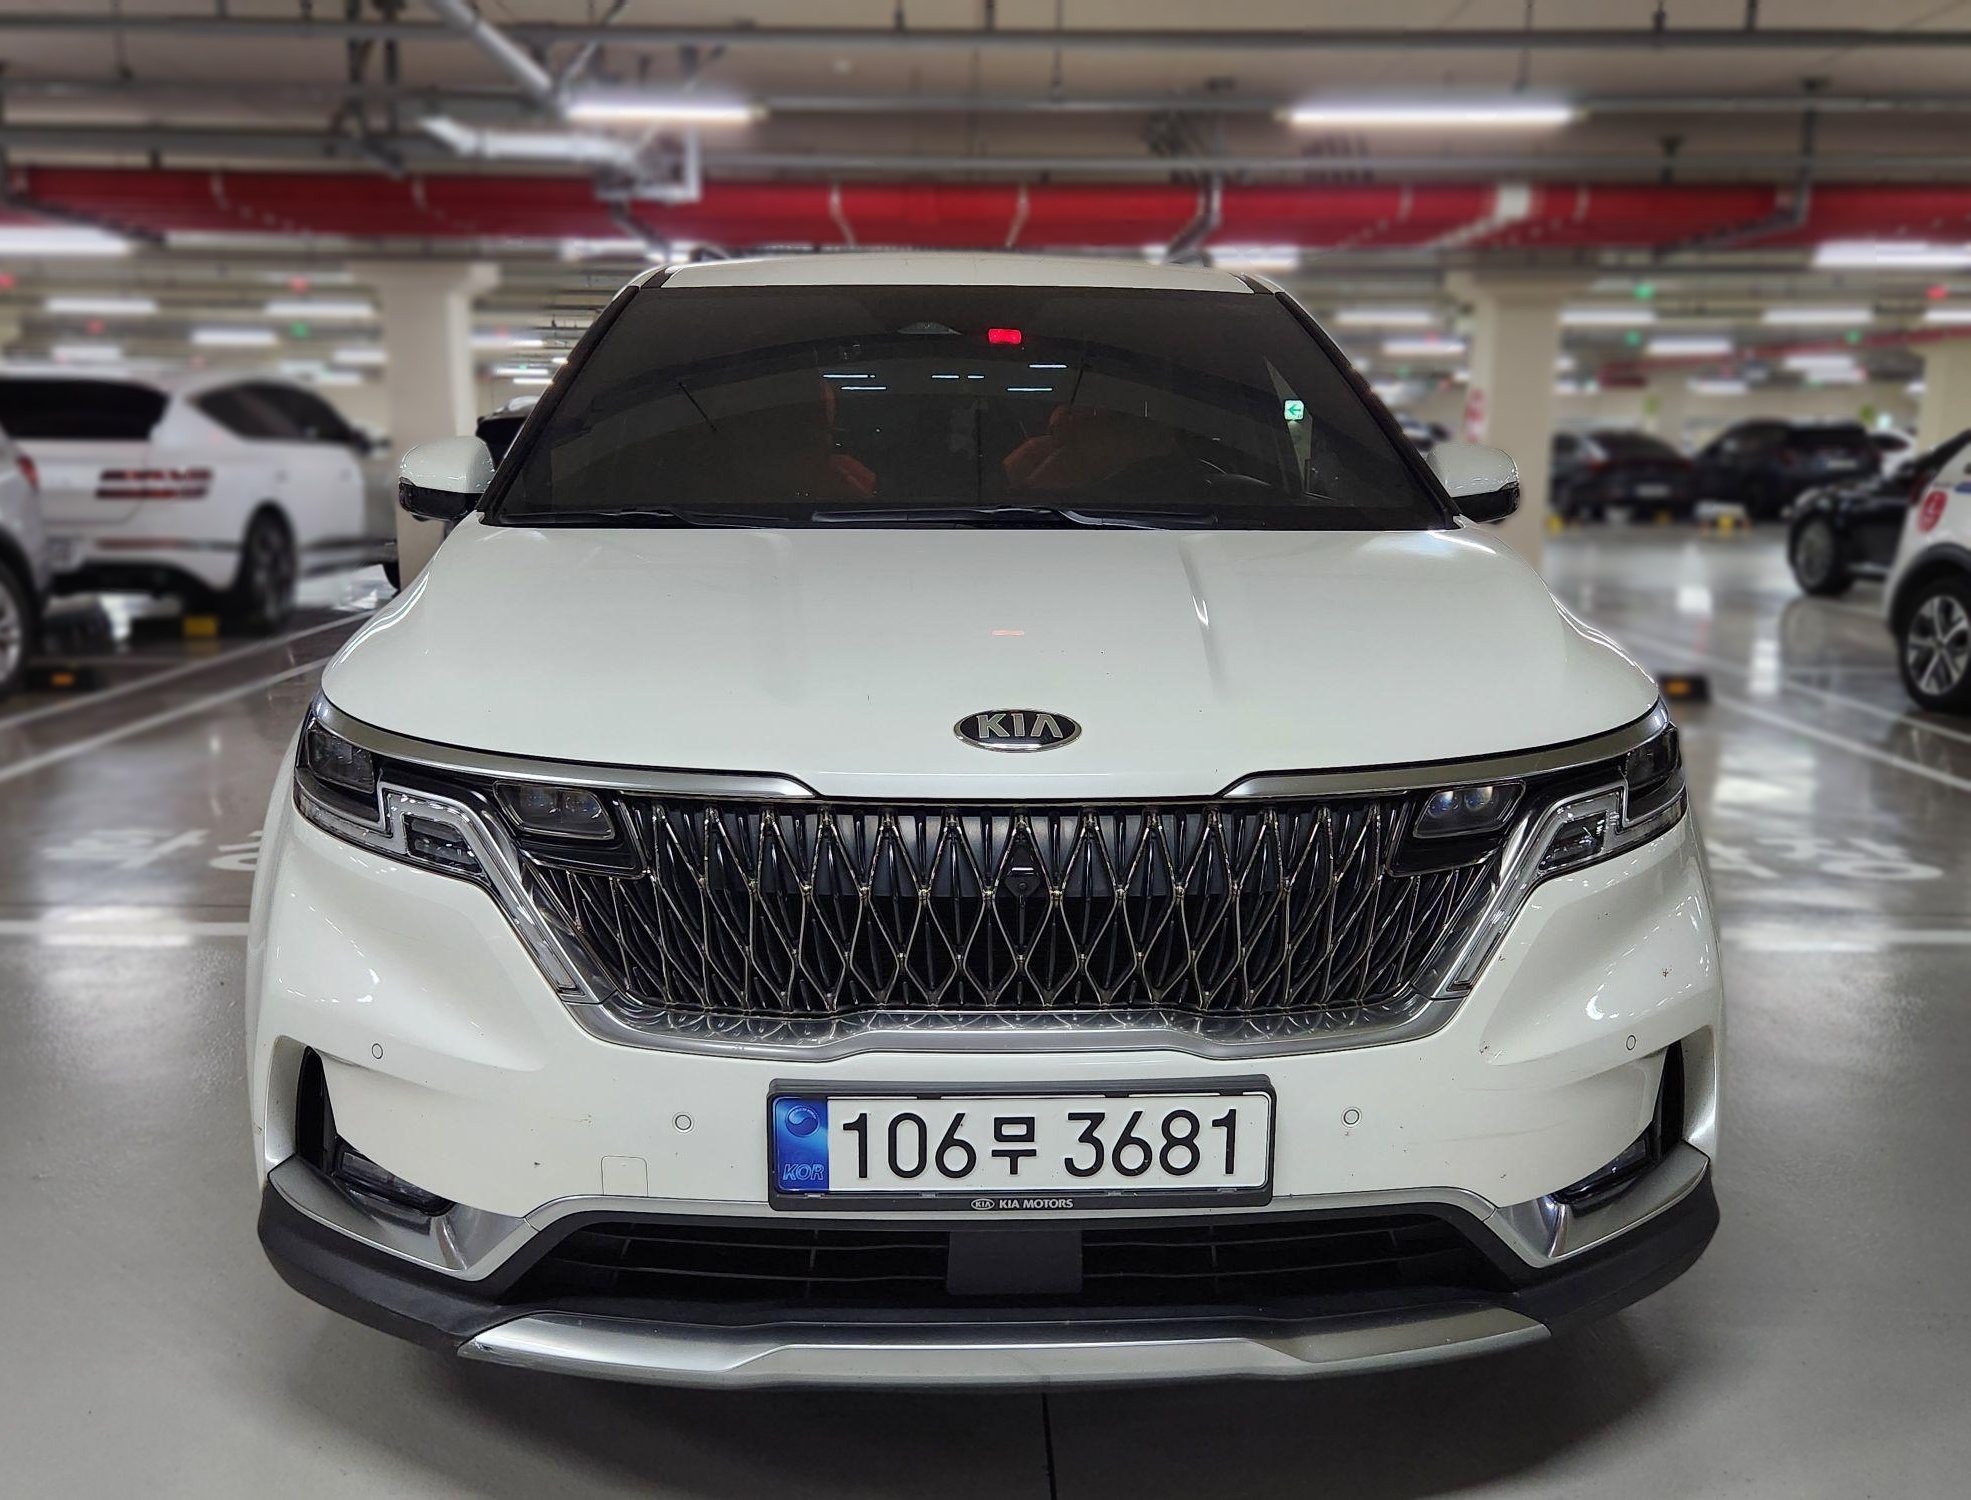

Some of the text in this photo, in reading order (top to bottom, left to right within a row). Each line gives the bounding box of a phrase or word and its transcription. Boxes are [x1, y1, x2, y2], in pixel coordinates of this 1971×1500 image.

[976, 713, 1063, 738] KIA
[843, 1109, 1237, 1178] 106무 3681
[782, 1164, 825, 1181] KOR
[999, 1199, 1074, 1209] KIA MOTORS
